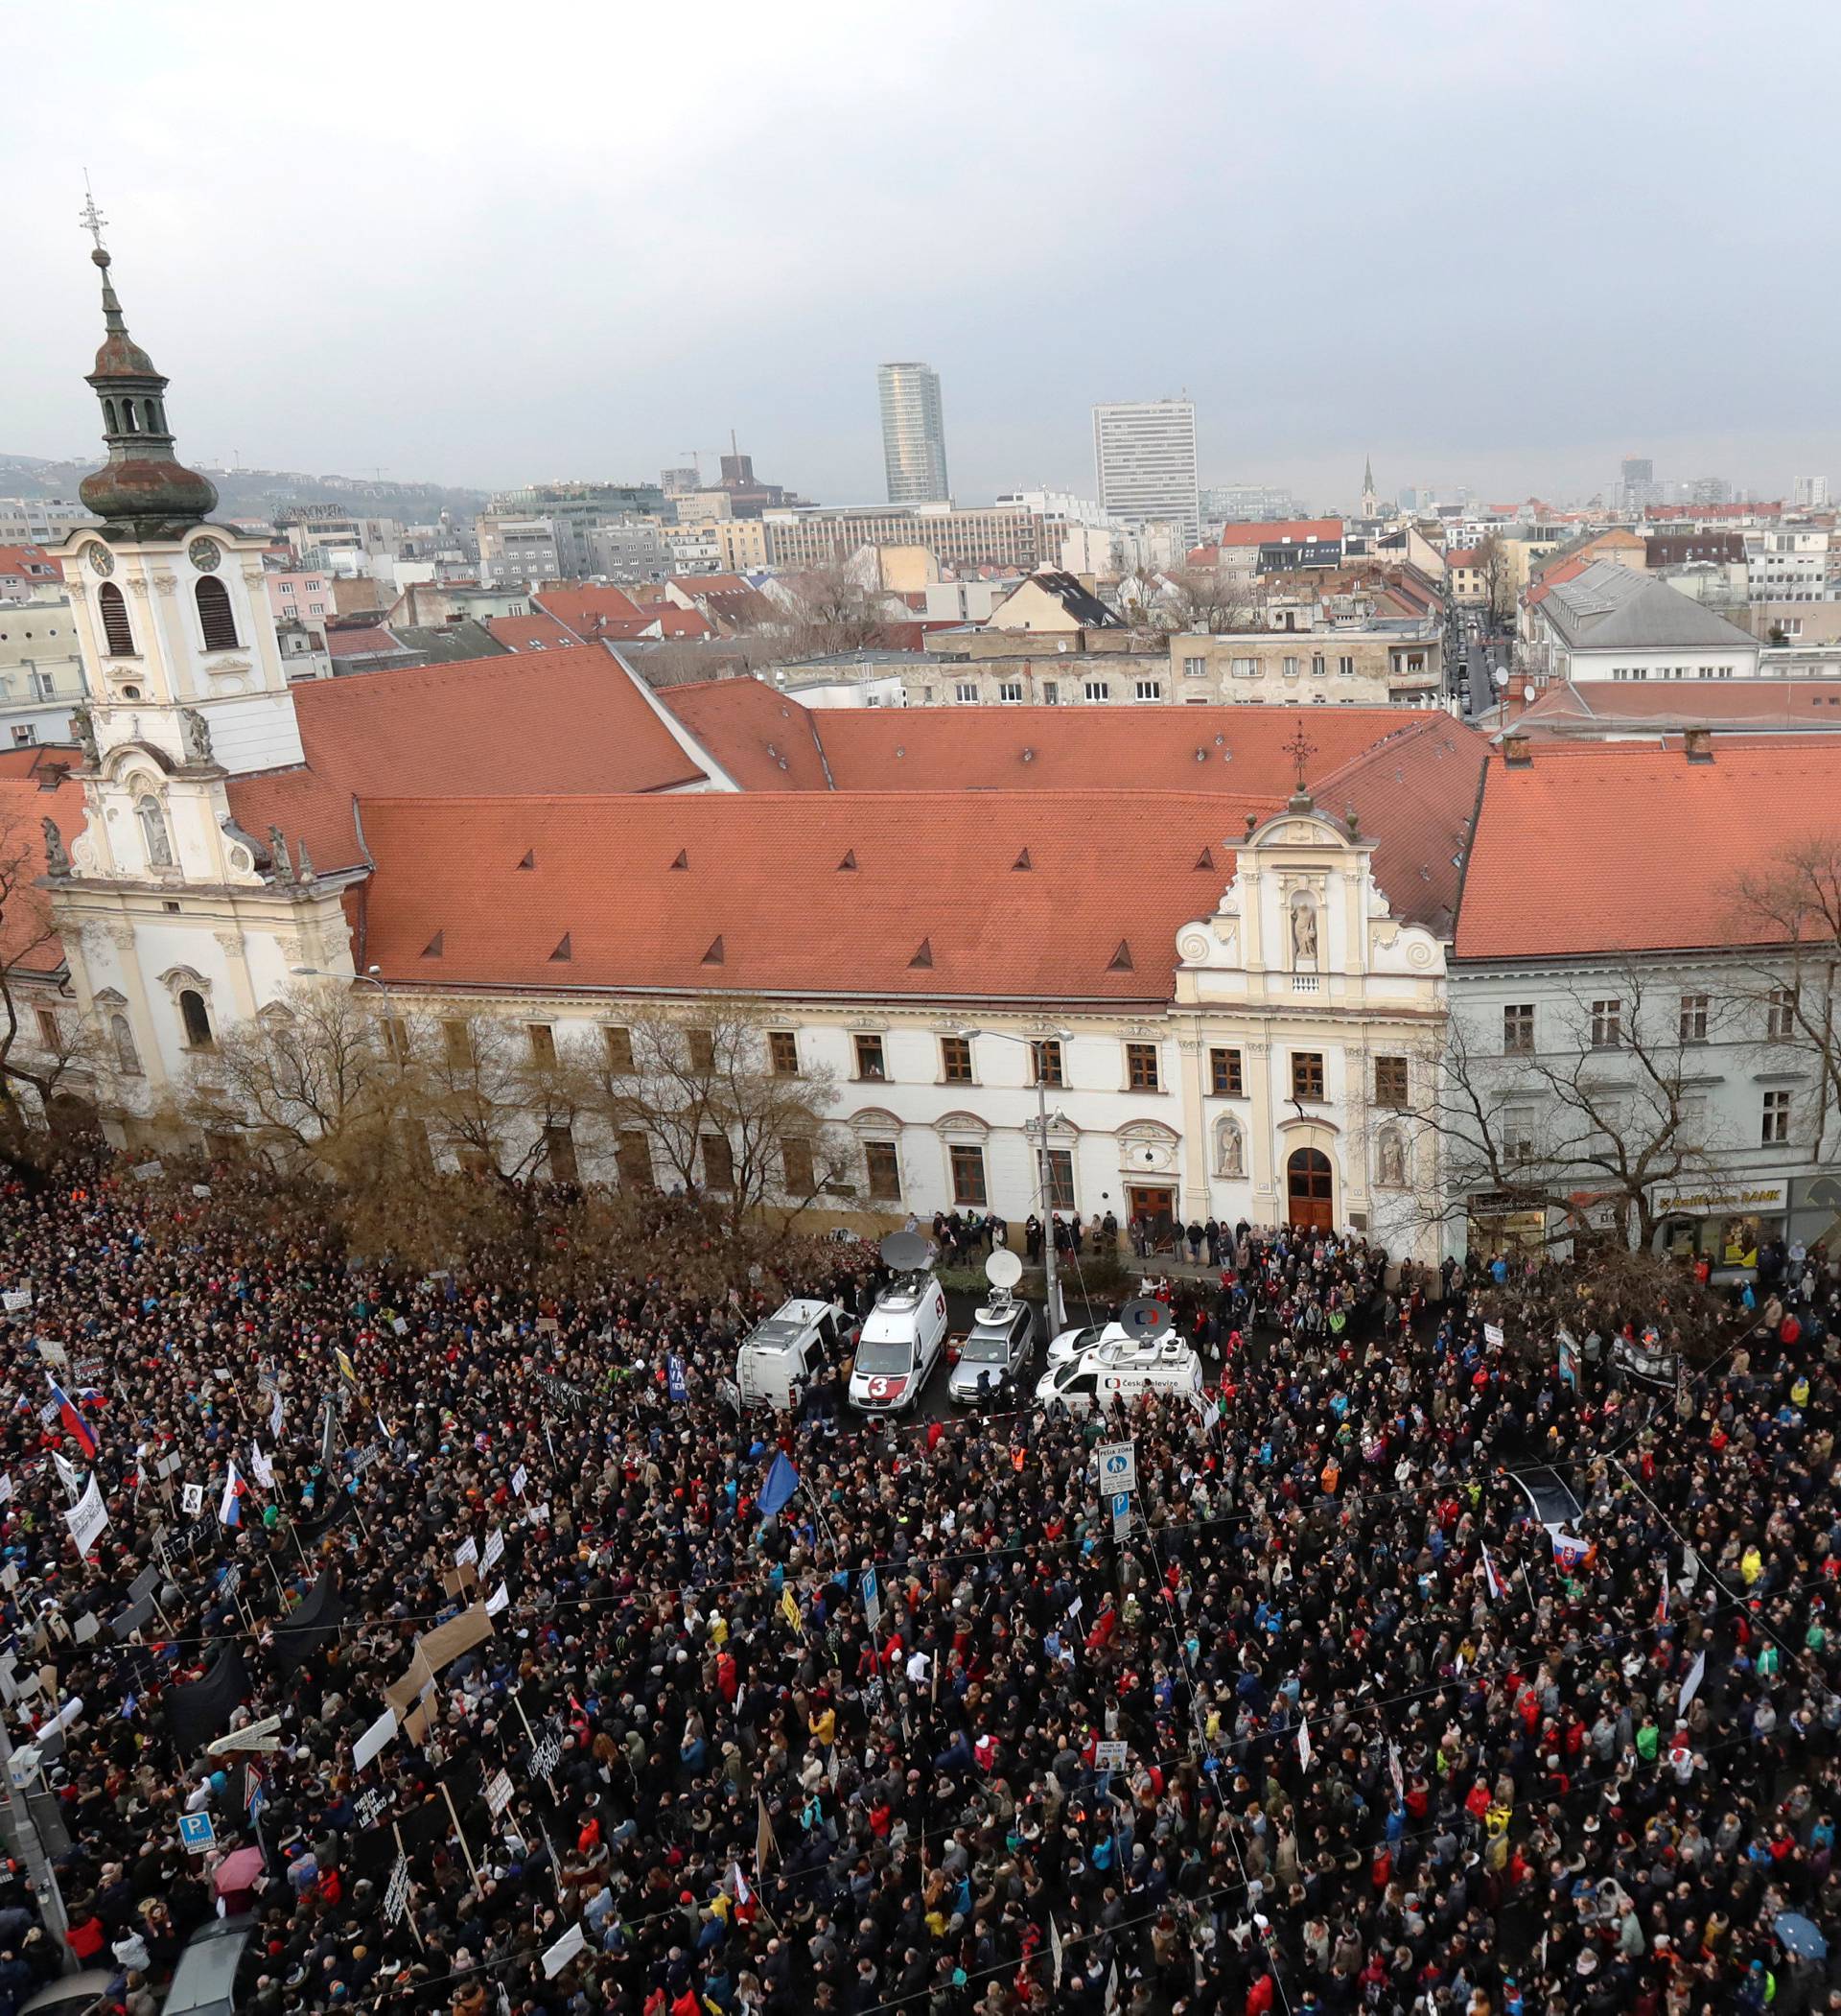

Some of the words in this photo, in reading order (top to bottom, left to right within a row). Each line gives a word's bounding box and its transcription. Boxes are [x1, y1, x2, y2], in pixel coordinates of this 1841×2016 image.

[871, 1377, 888, 1396] 3
[1117, 1495, 1124, 1510] P
[187, 1818, 201, 1835] P
